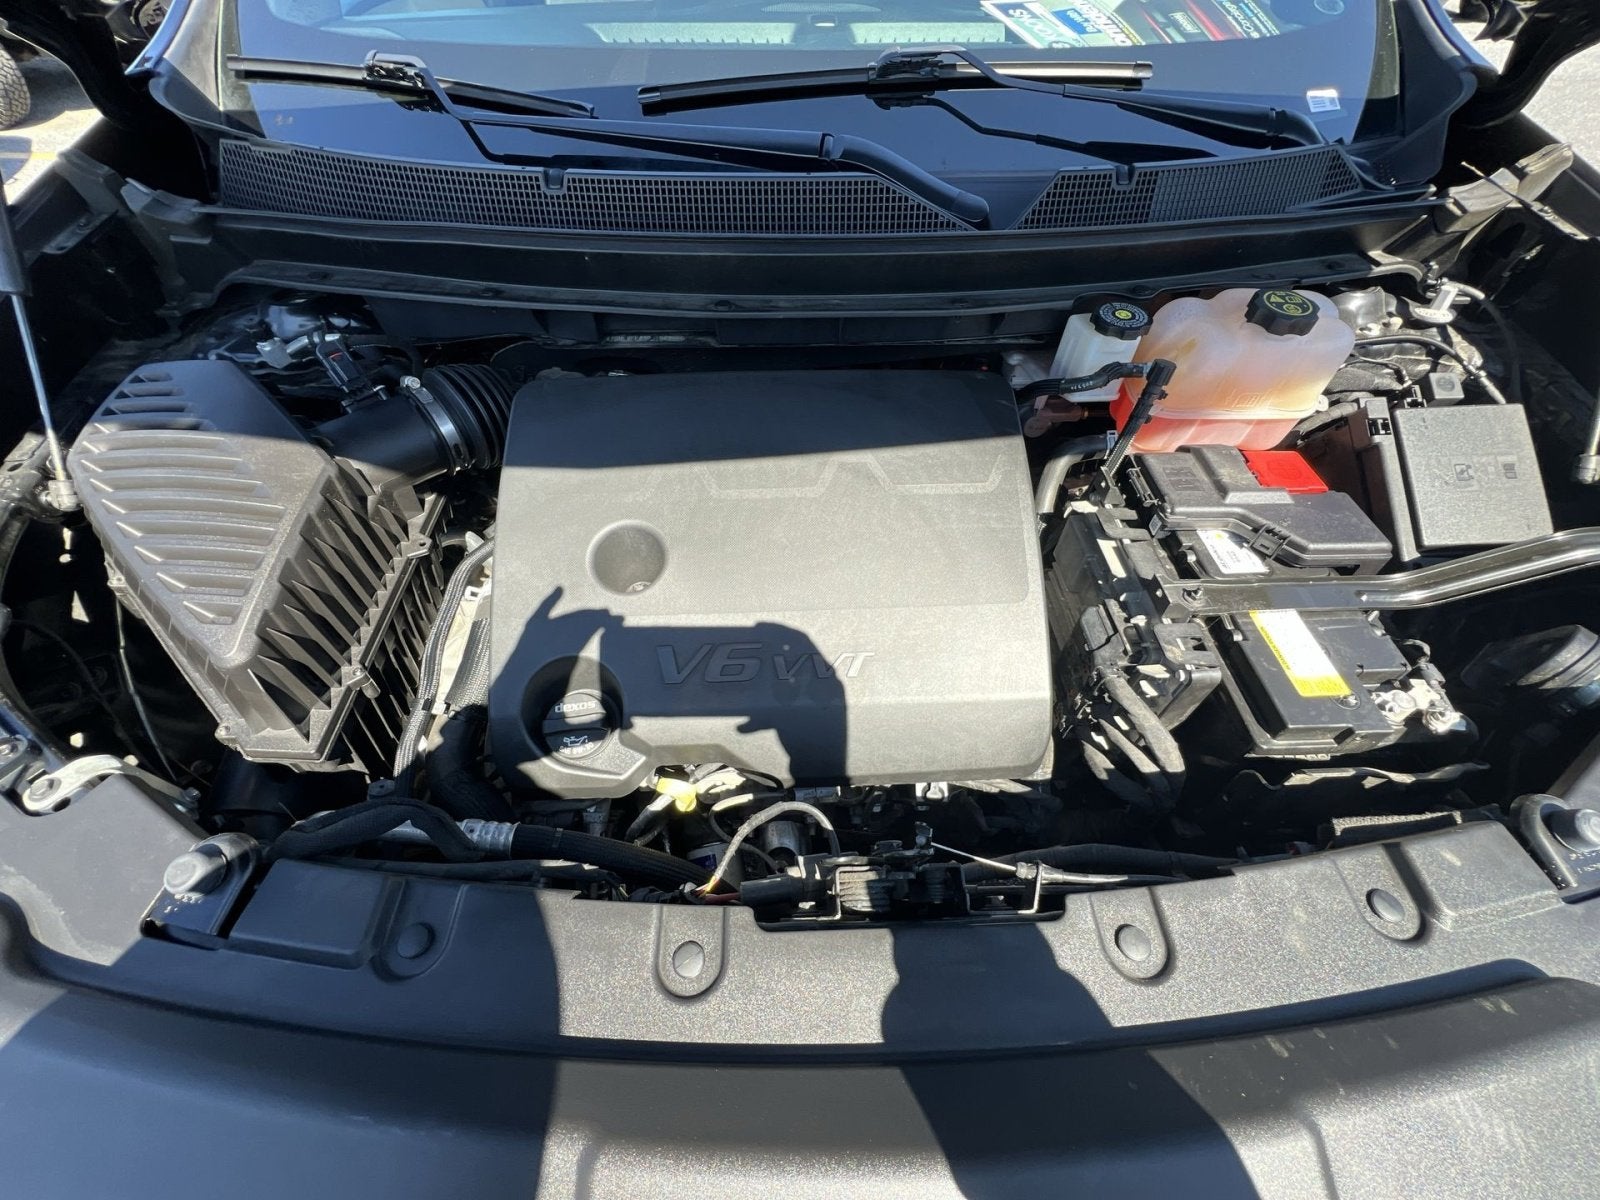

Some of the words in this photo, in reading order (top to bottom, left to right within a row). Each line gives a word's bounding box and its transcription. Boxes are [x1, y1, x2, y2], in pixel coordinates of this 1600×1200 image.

[656, 641, 763, 685] V6
[773, 651, 875, 680] VVT
[554, 700, 597, 713] dexos
